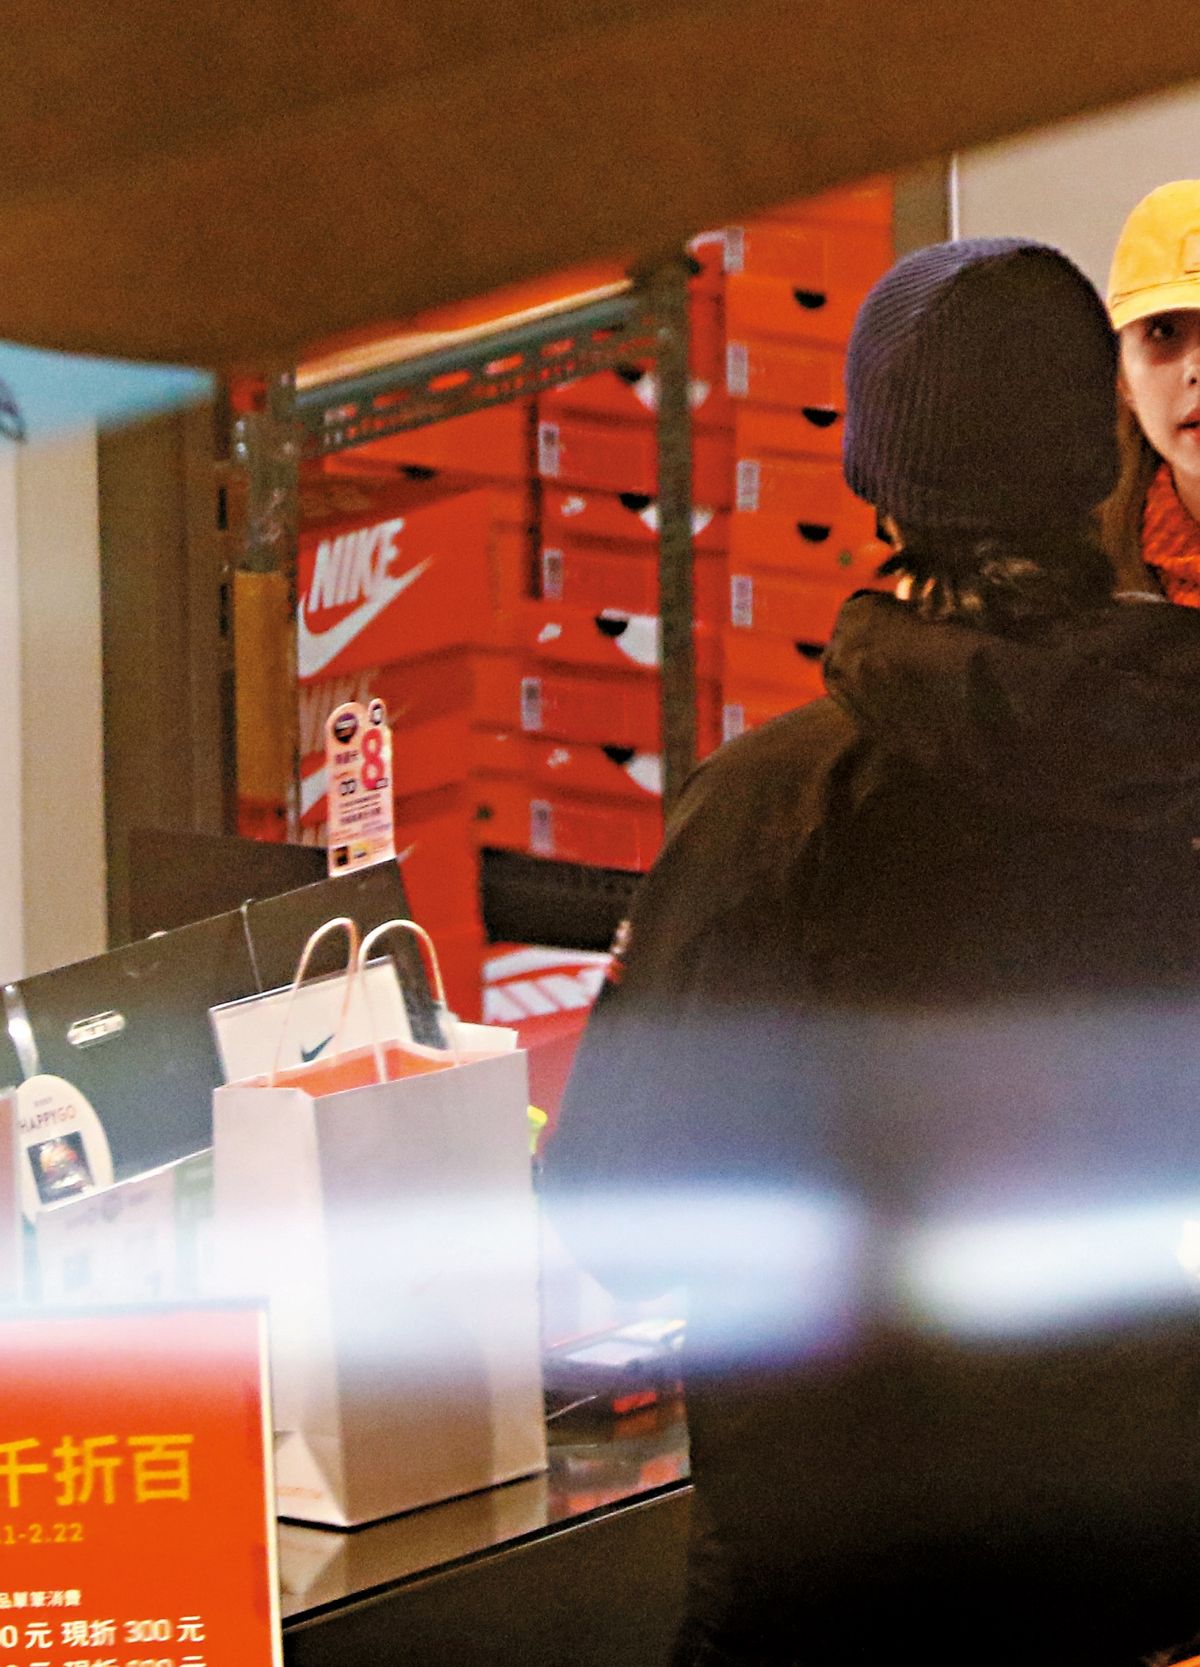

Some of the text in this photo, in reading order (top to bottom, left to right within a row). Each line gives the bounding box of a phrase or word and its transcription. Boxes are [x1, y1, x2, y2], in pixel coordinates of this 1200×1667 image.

[307, 517, 404, 613] NIKE
[361, 728, 385, 789] 8
[0, 1433, 194, 1508] 千折百
[176, 1615, 206, 1643] 元
